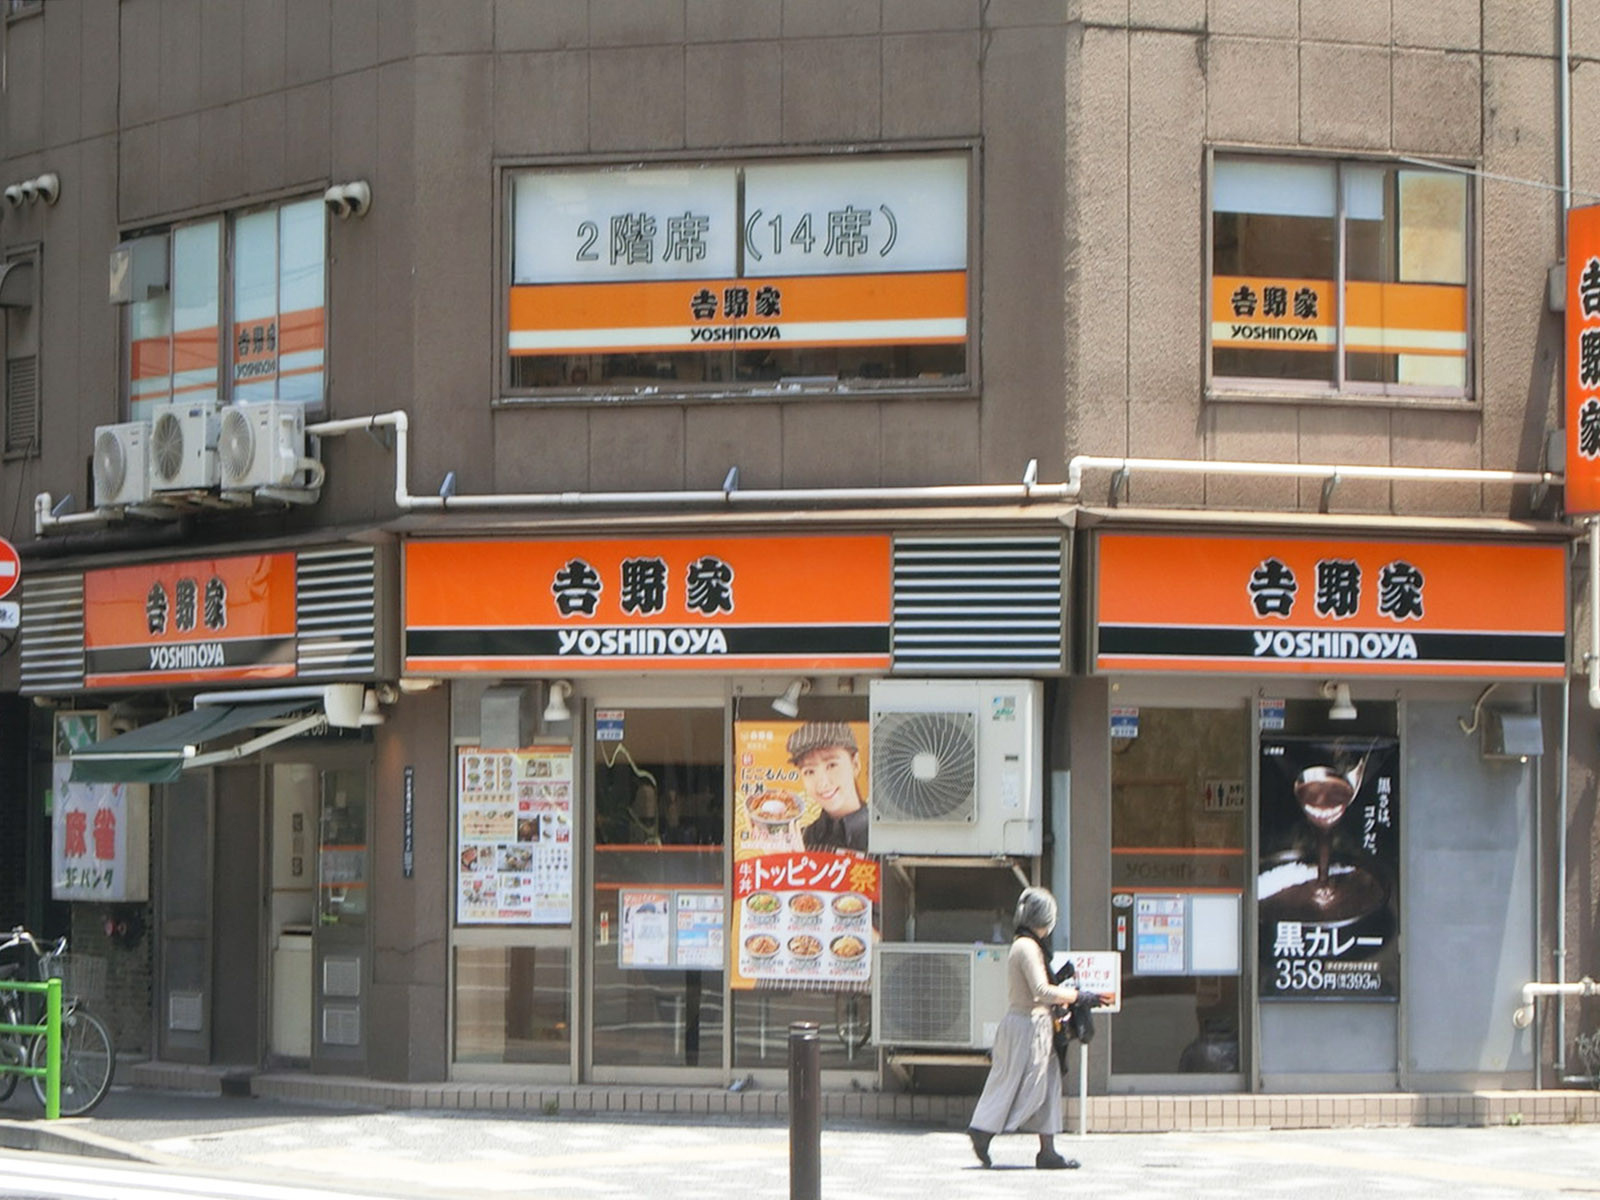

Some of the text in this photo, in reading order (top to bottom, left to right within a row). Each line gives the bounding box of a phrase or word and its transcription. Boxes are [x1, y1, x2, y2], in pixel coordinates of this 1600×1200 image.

[576, 211, 711, 264] 2階席
[691, 286, 781, 320] 吉野家
[1231, 286, 1318, 318] 吉野家
[690, 326, 781, 342] YOSHINOYA
[1231, 325, 1318, 342] YOSHINOYA
[551, 555, 735, 619] 吉野家
[1247, 557, 1425, 622] 吉野家
[145, 576, 228, 636] 吉野家
[150, 642, 225, 670] YOSHINOYA
[558, 628, 728, 655] YOSHINOYA
[1253, 631, 1418, 659] YOSHINOYA
[1273, 921, 1384, 957] 黒カレー
